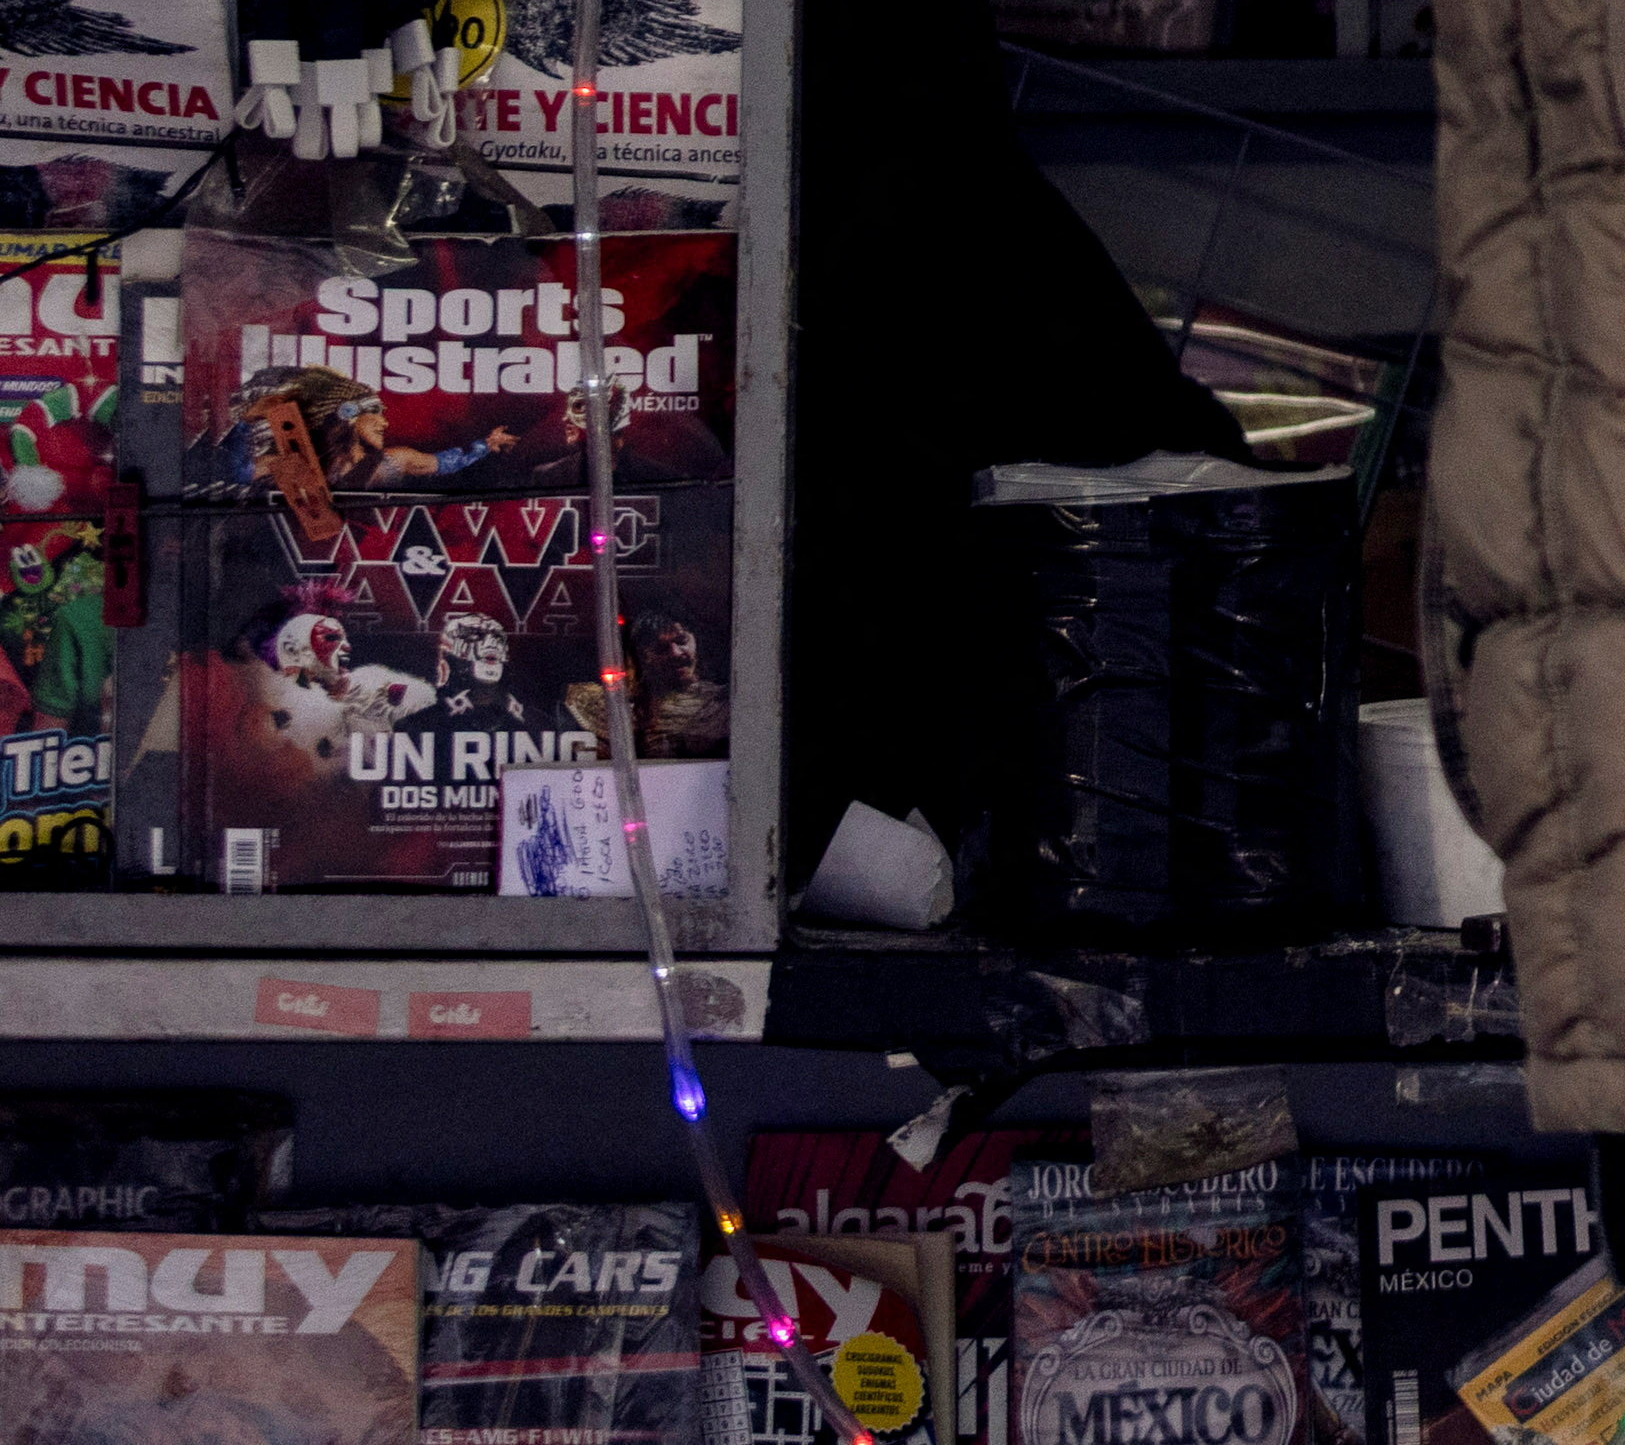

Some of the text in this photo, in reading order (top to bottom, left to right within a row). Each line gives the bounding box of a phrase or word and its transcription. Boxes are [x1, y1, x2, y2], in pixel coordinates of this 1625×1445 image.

[27, 71, 217, 120] CIENCIA
[480, 139, 568, 164] Gyotaku,
[316, 278, 624, 336] Sports
[241, 332, 700, 394] Illustrated
[628, 394, 700, 411] MÉXICO
[350, 732, 598, 780] UN RING
[382, 786, 436, 808] DOS
[1378, 1188, 1598, 1266] PENTH
[0, 1250, 394, 1333] muy
[517, 1252, 681, 1292] CARS
[1380, 1269, 1473, 1293] MÉXICO
[1060, 1385, 1275, 1445] MÉXICO
